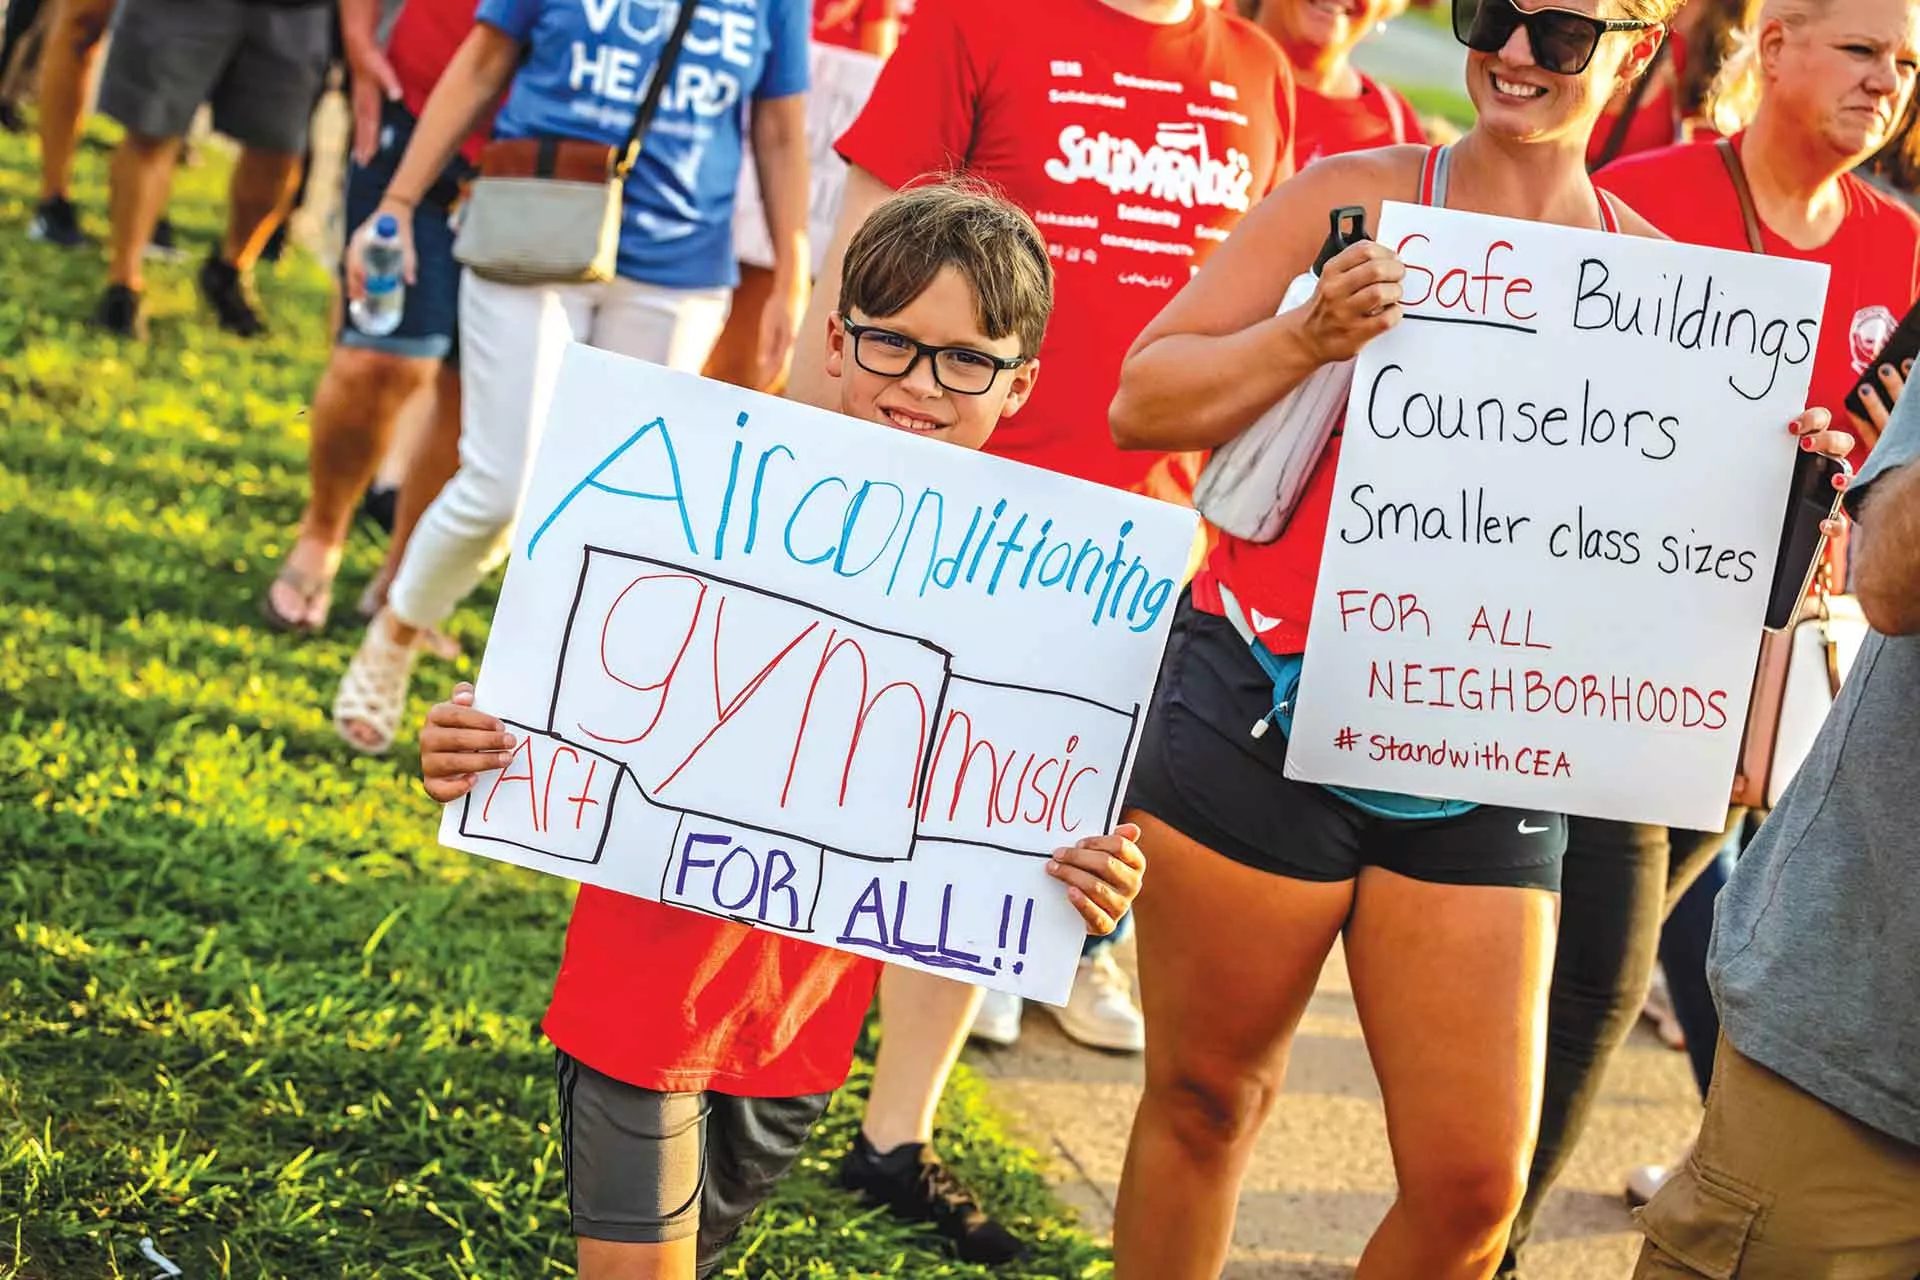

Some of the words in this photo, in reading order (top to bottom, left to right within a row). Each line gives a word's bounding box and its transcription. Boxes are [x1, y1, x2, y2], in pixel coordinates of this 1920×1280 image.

[1396, 233, 1537, 320] Safe
[1573, 258, 1817, 400] Buildings
[1368, 363, 1680, 460] Counselors
[1341, 484, 1530, 545] Smaller
[1549, 505, 1641, 565] class
[1337, 589, 1430, 637] FOR
[1468, 605, 1552, 650] ALL
[578, 573, 925, 808] gym
[1368, 660, 1728, 730] NEIGHBORHOODS
[482, 734, 600, 833] Art
[919, 708, 1098, 832] music
[675, 832, 800, 929] FOR
[840, 877, 1034, 976] ALL!!
